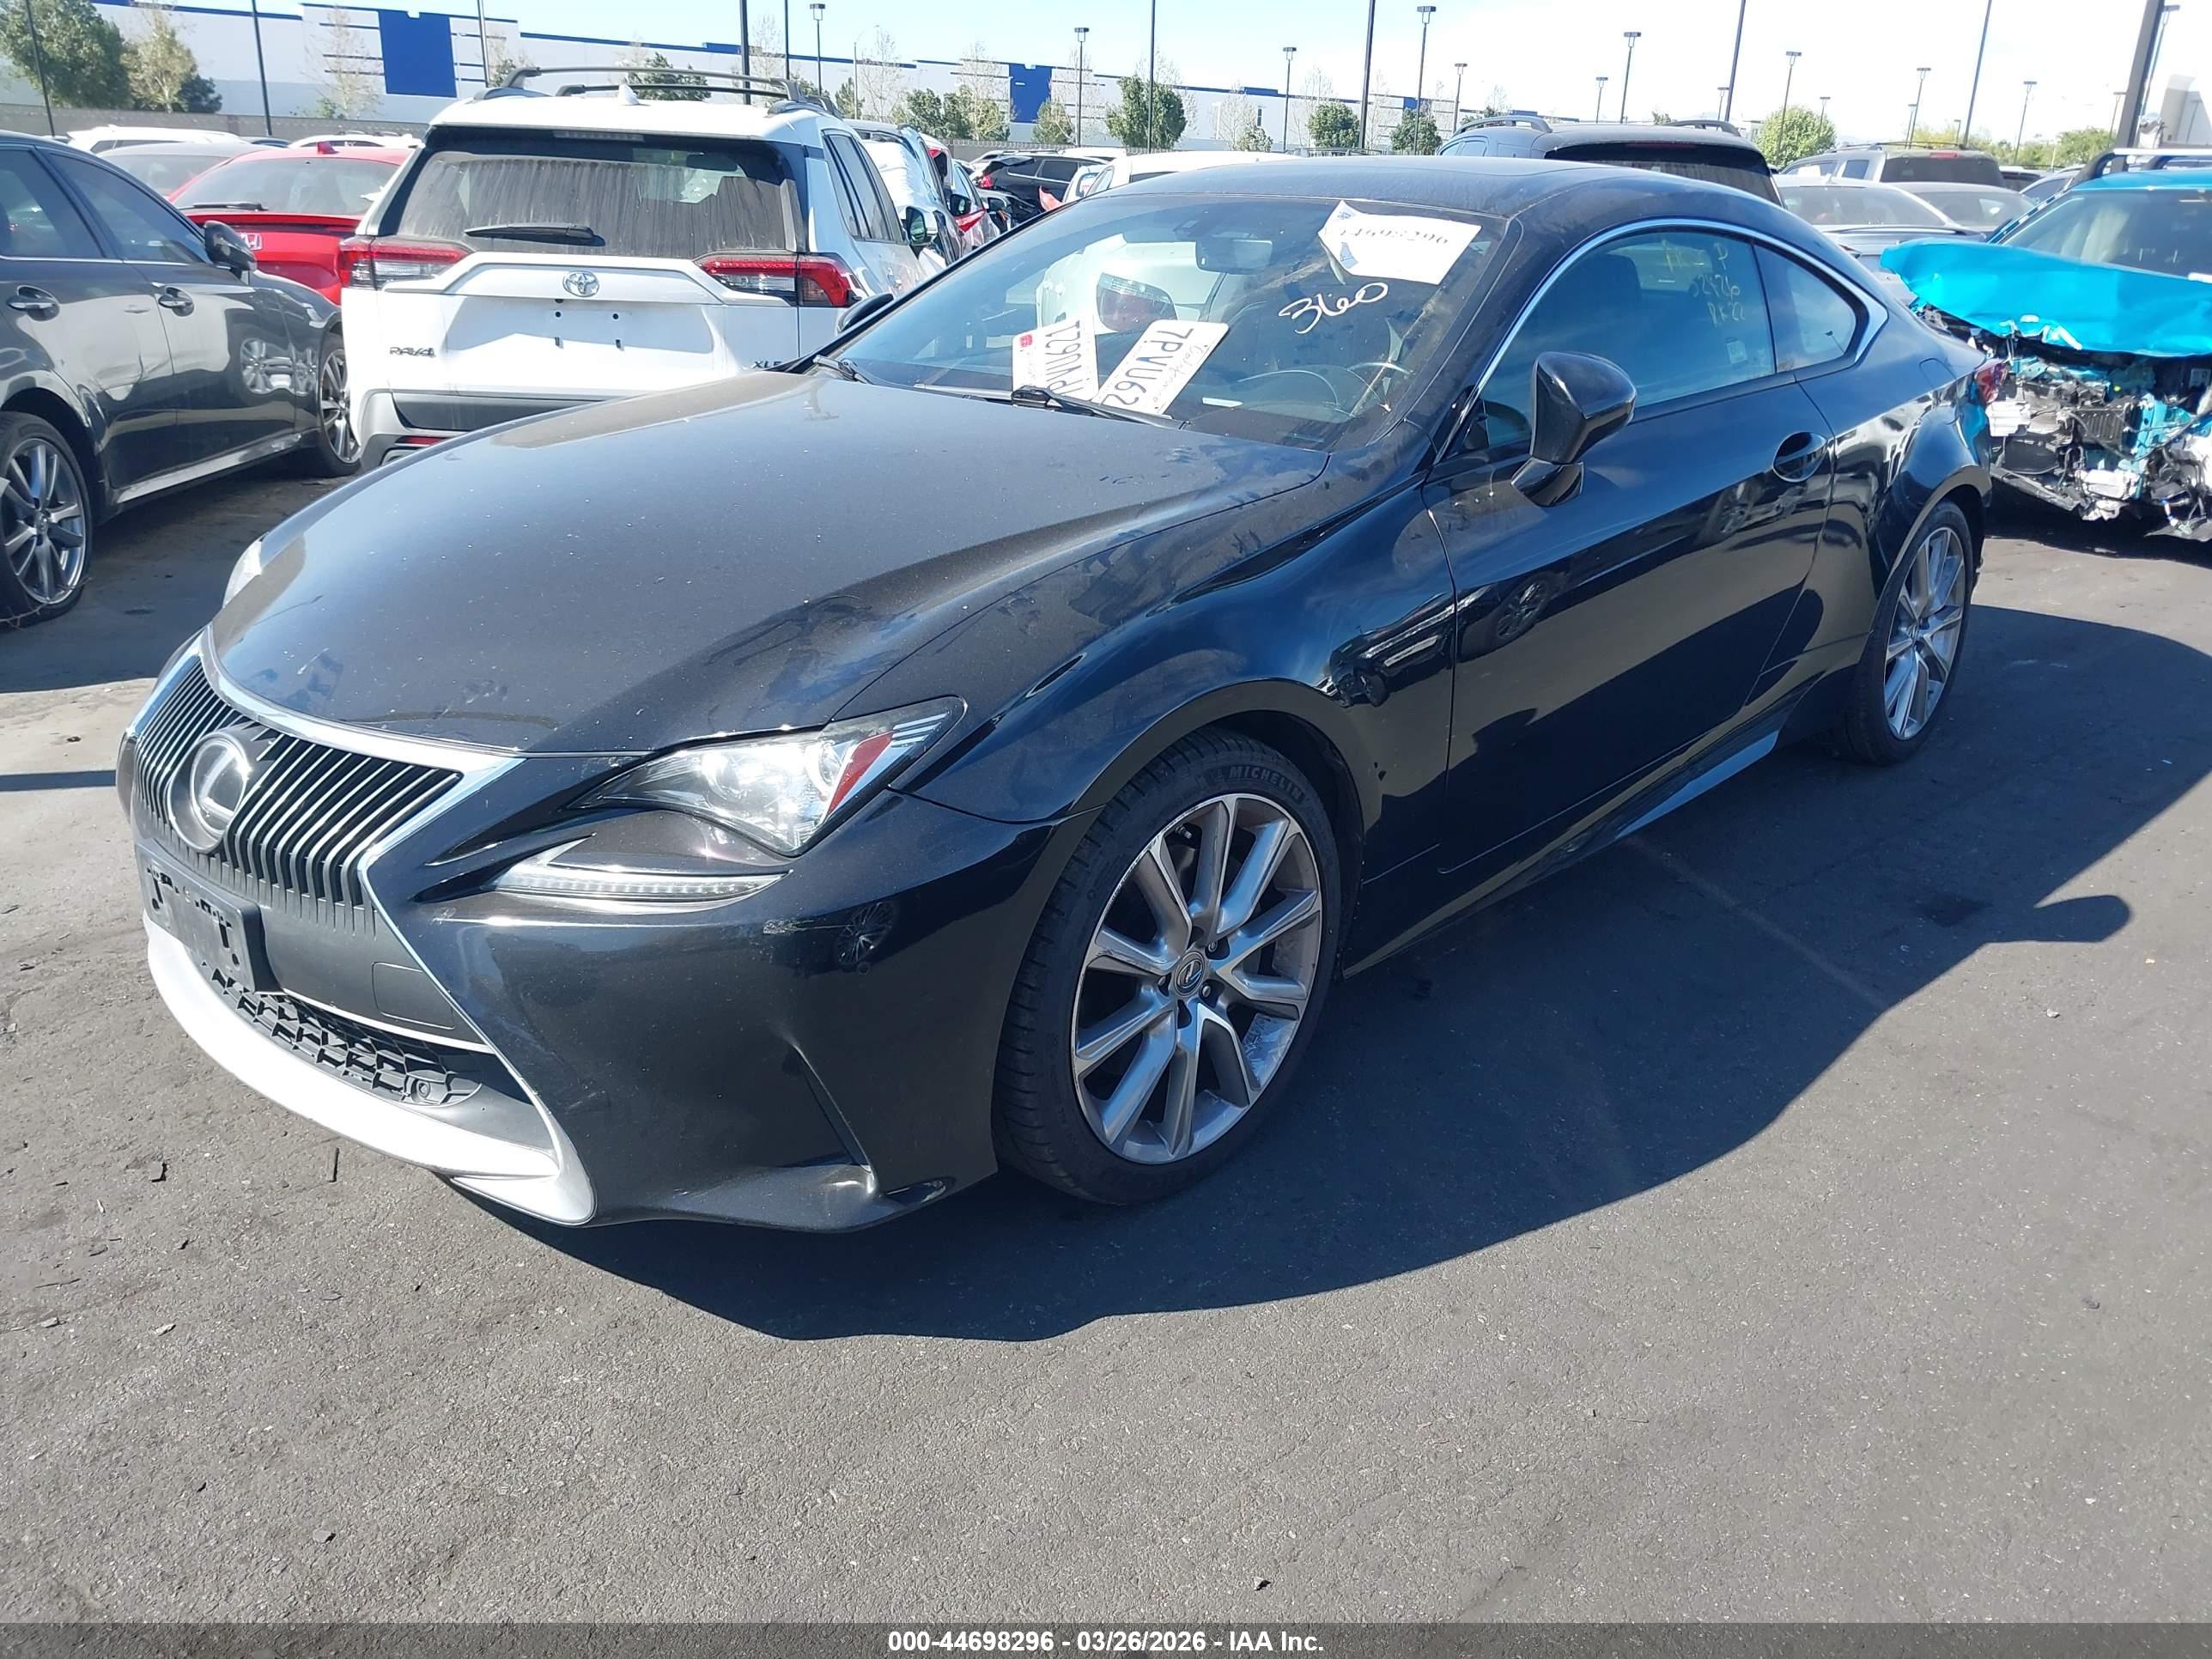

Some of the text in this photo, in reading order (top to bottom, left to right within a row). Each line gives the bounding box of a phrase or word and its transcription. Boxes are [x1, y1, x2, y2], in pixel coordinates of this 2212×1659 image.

[389, 347, 436, 358] RAV4
[1100, 328, 1194, 406] 7PVU62
[1229, 765, 1304, 800] MICHELIN
